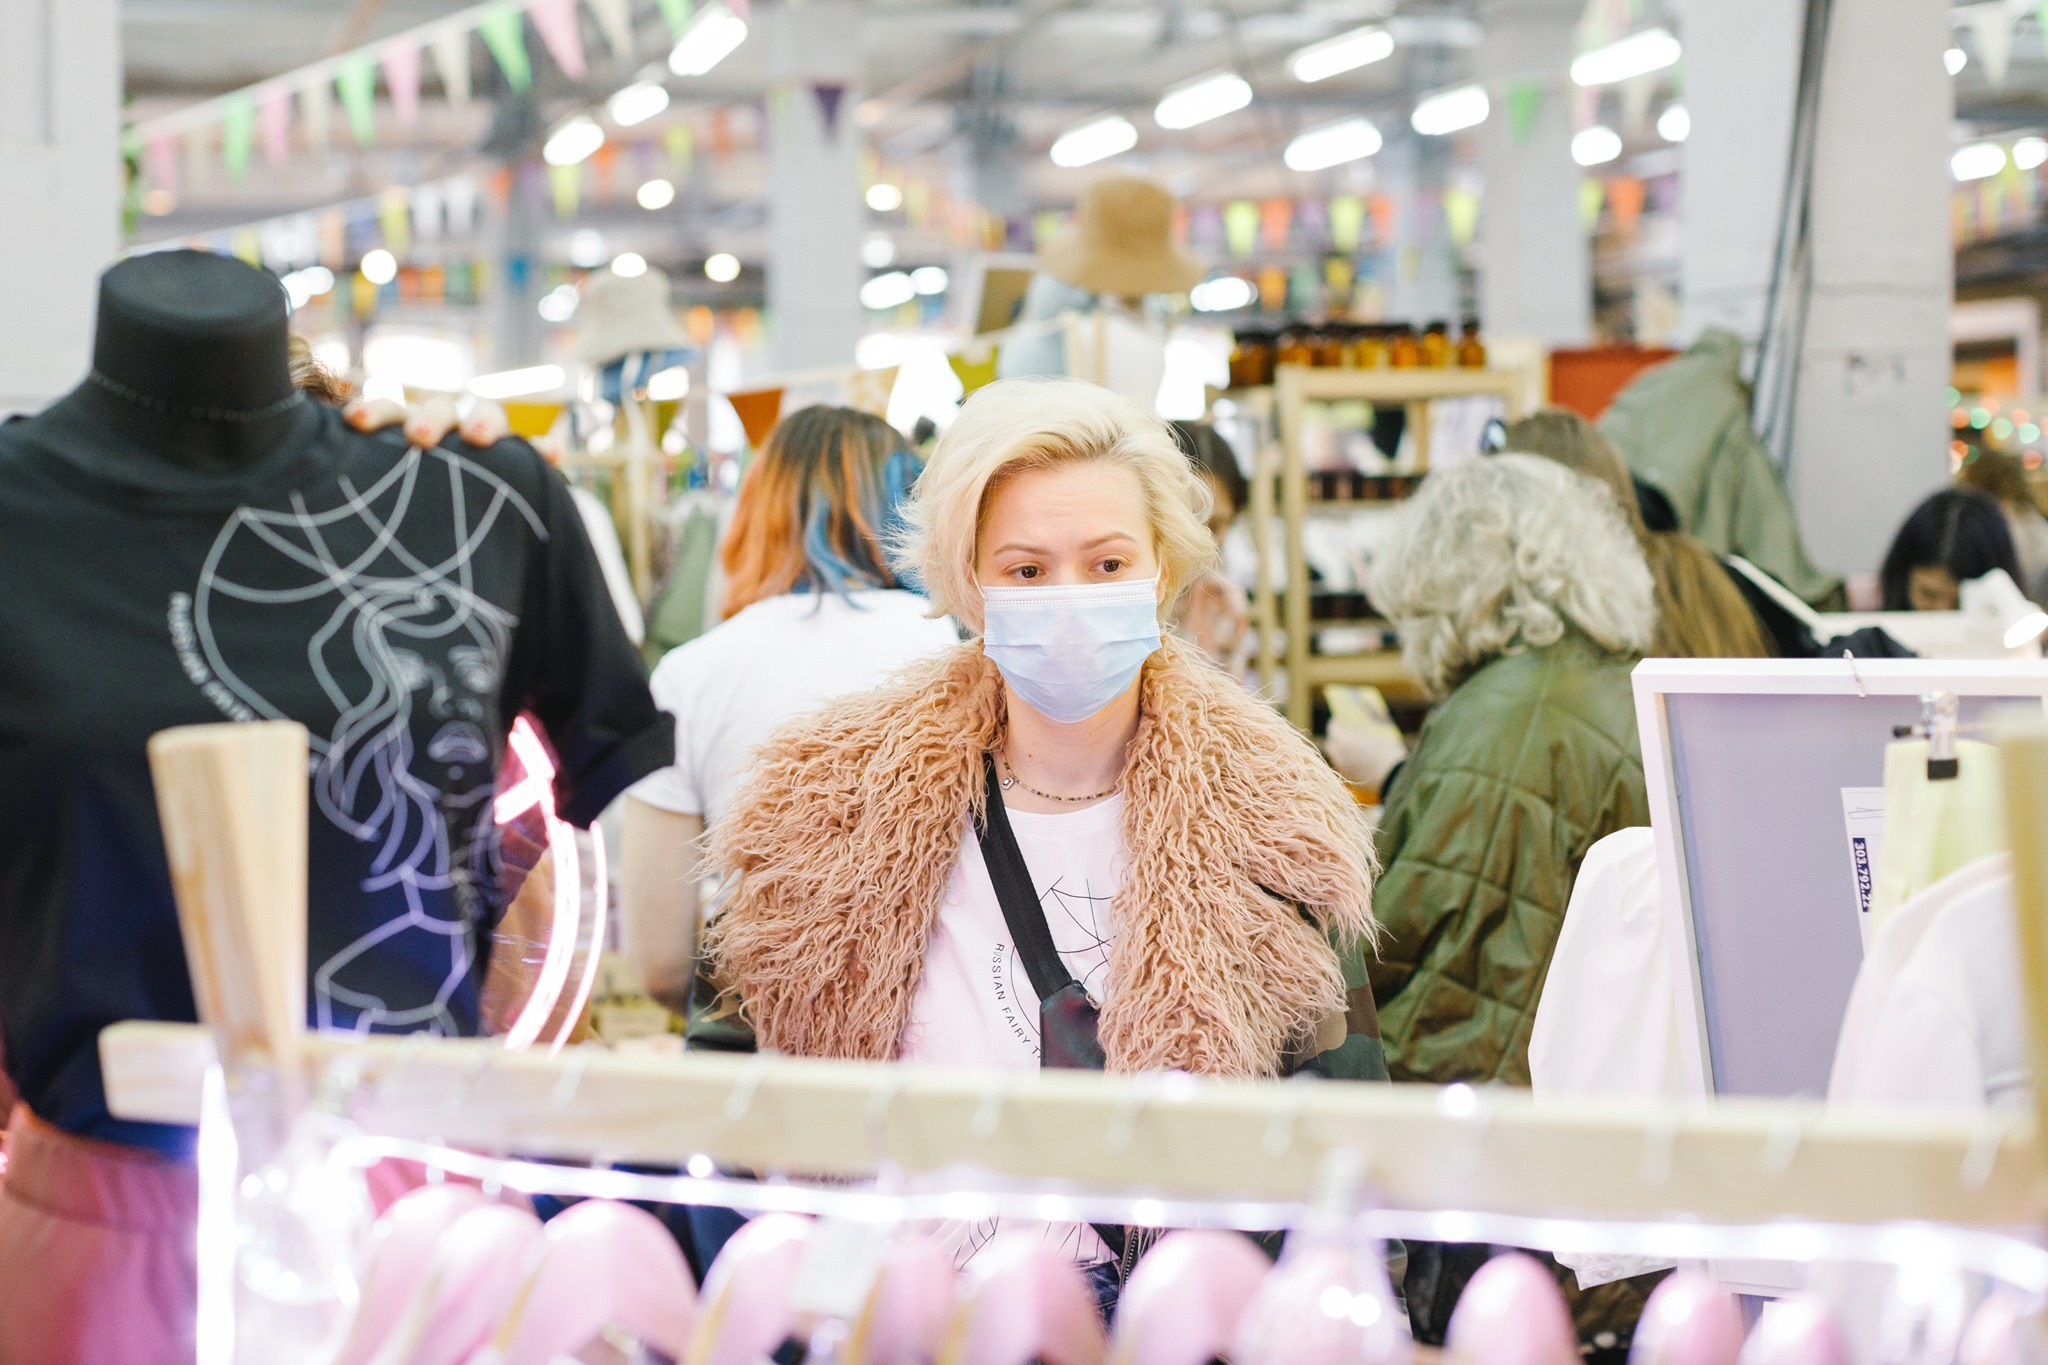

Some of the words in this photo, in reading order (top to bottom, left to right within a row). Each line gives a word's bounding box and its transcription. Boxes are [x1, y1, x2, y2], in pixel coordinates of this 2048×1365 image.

[1854, 842, 1872, 909] 303.792.22
[992, 943, 1006, 1001] RUSSIAN
[1001, 1006, 1031, 1044] FAIRY
[1032, 1045, 1042, 1059] T
